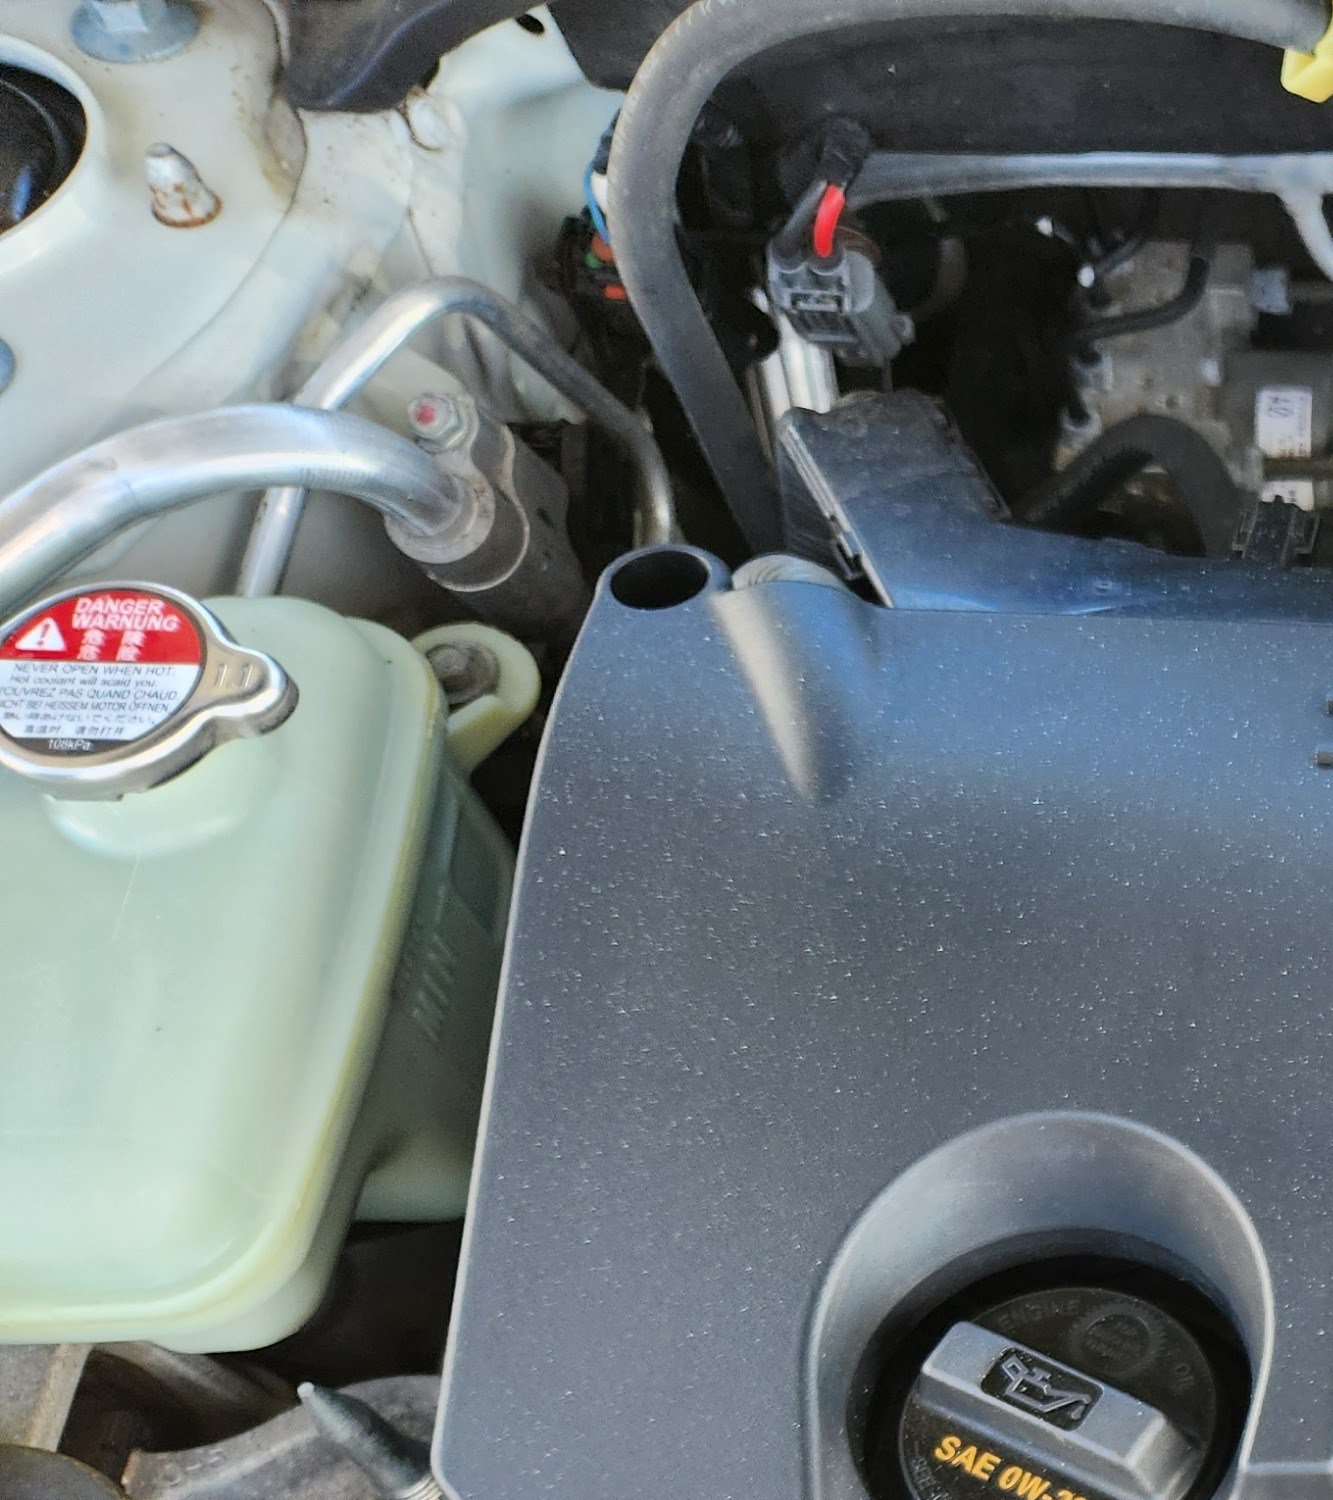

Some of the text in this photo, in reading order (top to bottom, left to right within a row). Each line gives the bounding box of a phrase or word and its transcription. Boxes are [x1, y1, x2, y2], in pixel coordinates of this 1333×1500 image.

[75, 597, 164, 615] DANGER
[72, 612, 180, 632] WARNUNG
[13, 663, 58, 674] NEVER
[62, 664, 99, 675] OPEN
[103, 665, 142, 675] WHEN
[80, 676, 97, 686] will
[60, 688, 85, 699] PAS
[87, 689, 131, 700] QUAND
[134, 690, 178, 701] CHAUD
[91, 702, 126, 712] MOTOR
[934, 1435, 1002, 1481] SAE
